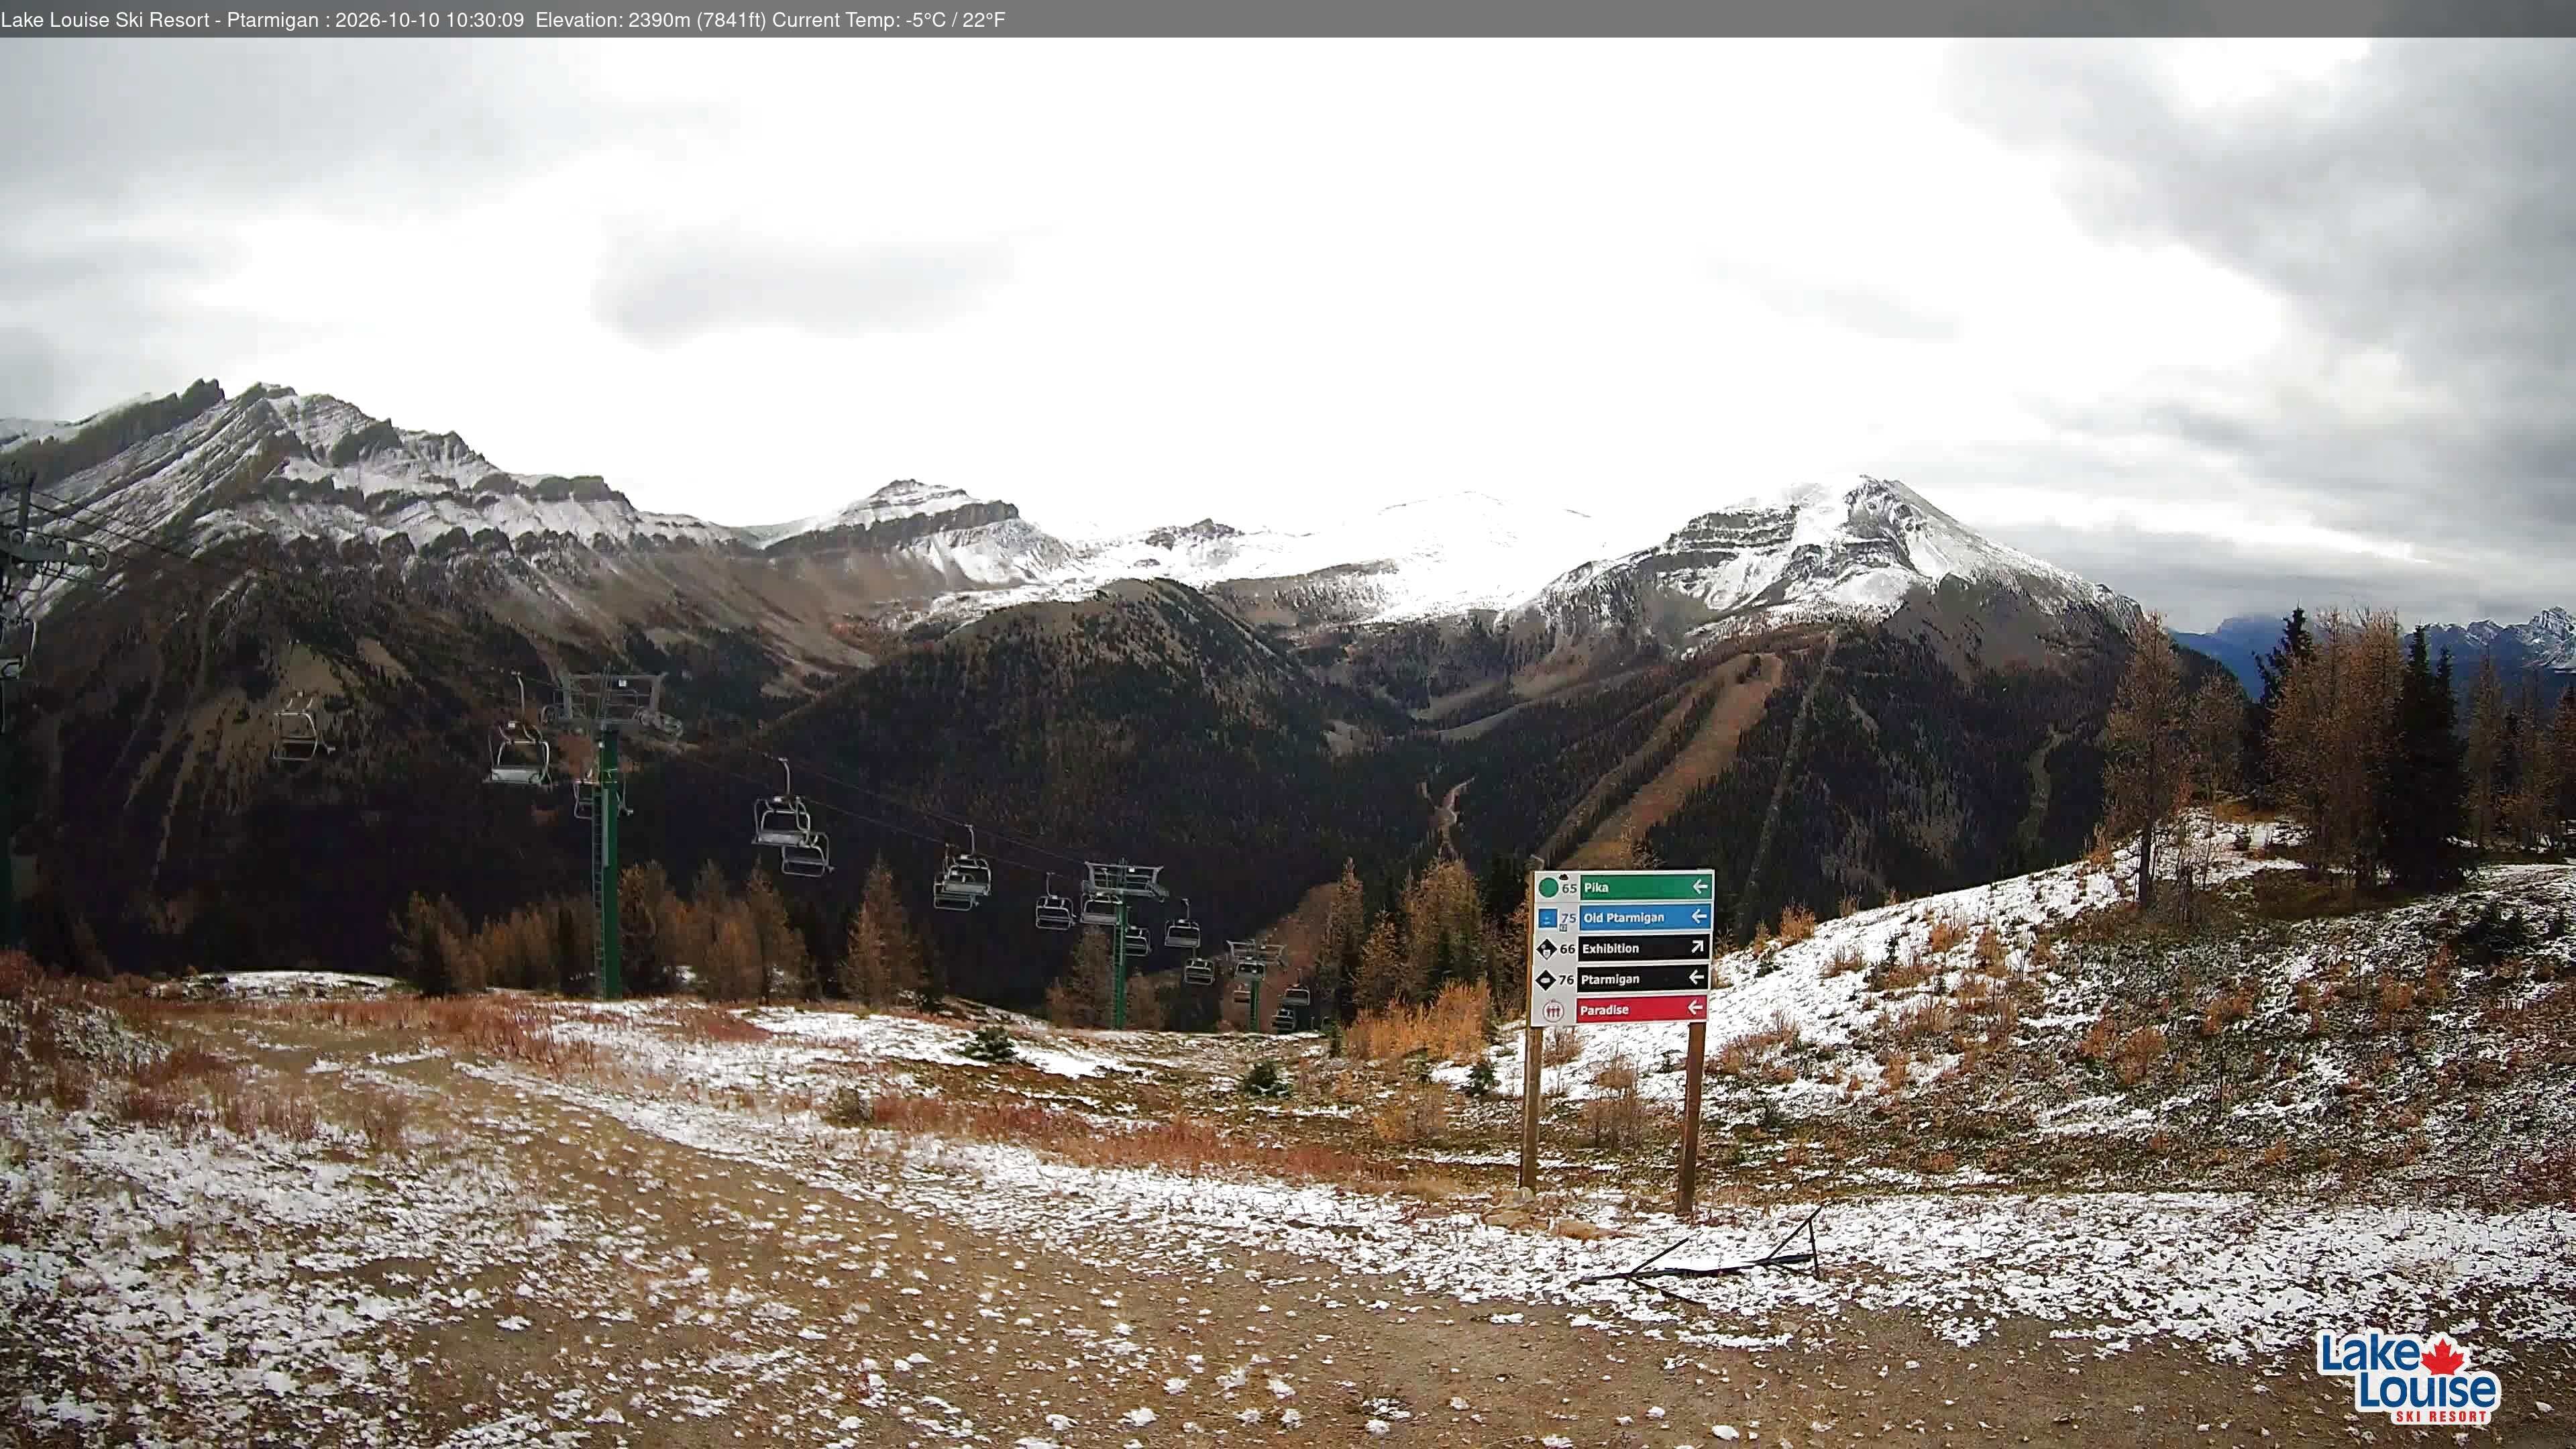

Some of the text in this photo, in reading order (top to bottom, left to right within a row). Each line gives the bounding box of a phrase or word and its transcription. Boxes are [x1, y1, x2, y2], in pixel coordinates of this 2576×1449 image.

[1562, 882, 1609, 894] 65 Pika
[1561, 912, 1664, 924] 75 Old Ptarmigan
[1560, 943, 1640, 954] 66 Exhibition
[1559, 974, 1640, 986] 76 Ptarmigan
[1580, 1004, 1629, 1016] Paradise
